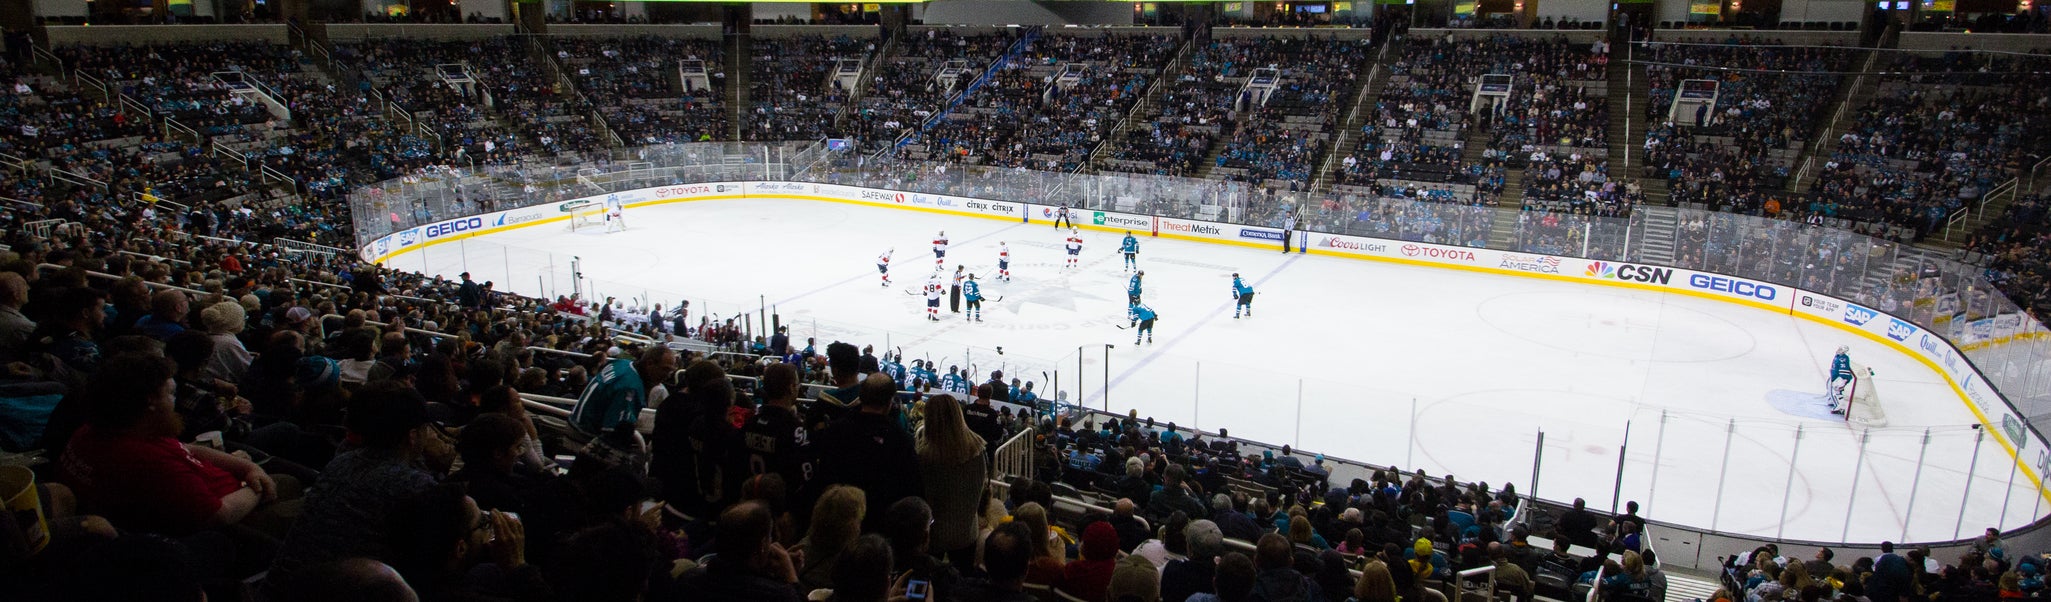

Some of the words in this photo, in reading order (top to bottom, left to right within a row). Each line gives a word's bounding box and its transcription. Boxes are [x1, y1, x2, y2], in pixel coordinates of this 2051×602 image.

[672, 186, 710, 196] TOYOTA
[861, 190, 895, 201] SAFEWAY
[426, 217, 482, 238] GEICO
[1097, 214, 1148, 227] enterprise
[1163, 221, 1220, 235] ThreatMetrix
[401, 232, 417, 244] SAP
[1329, 237, 1359, 250] Coors
[1360, 243, 1387, 253] LIGHT
[1422, 247, 1475, 261] TOYOTA
[1501, 253, 1535, 263] SOLAR
[1499, 261, 1559, 274] AMERICA
[1617, 264, 1674, 285] CSN
[1690, 273, 1777, 301] GEICO
[1845, 307, 1871, 324] SAP
[1888, 321, 1911, 340] SAP
